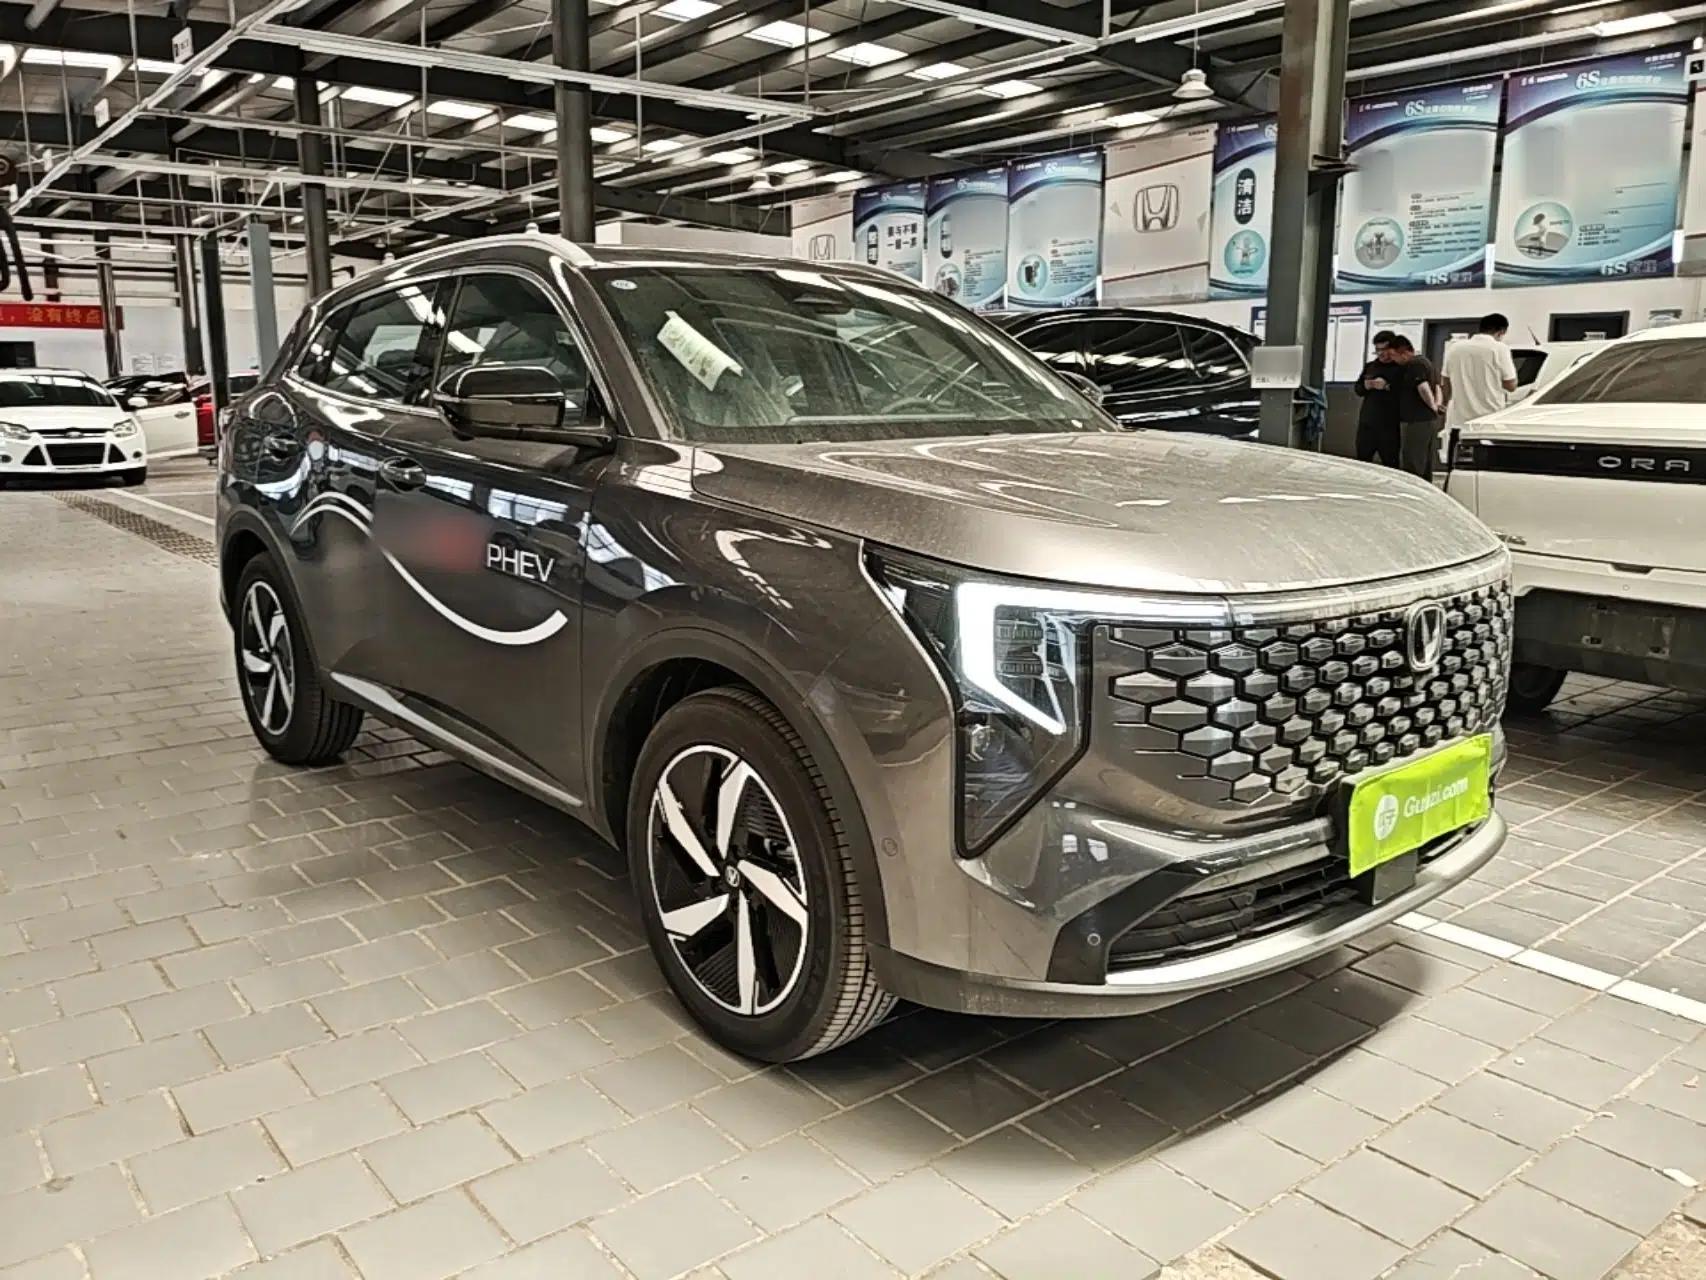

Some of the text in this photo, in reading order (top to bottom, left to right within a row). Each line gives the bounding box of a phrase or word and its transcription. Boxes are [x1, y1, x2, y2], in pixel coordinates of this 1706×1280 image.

[0, 306, 102, 324] ，没有终点
[1598, 455, 1691, 473] ORA
[486, 543, 555, 583] PHEV
